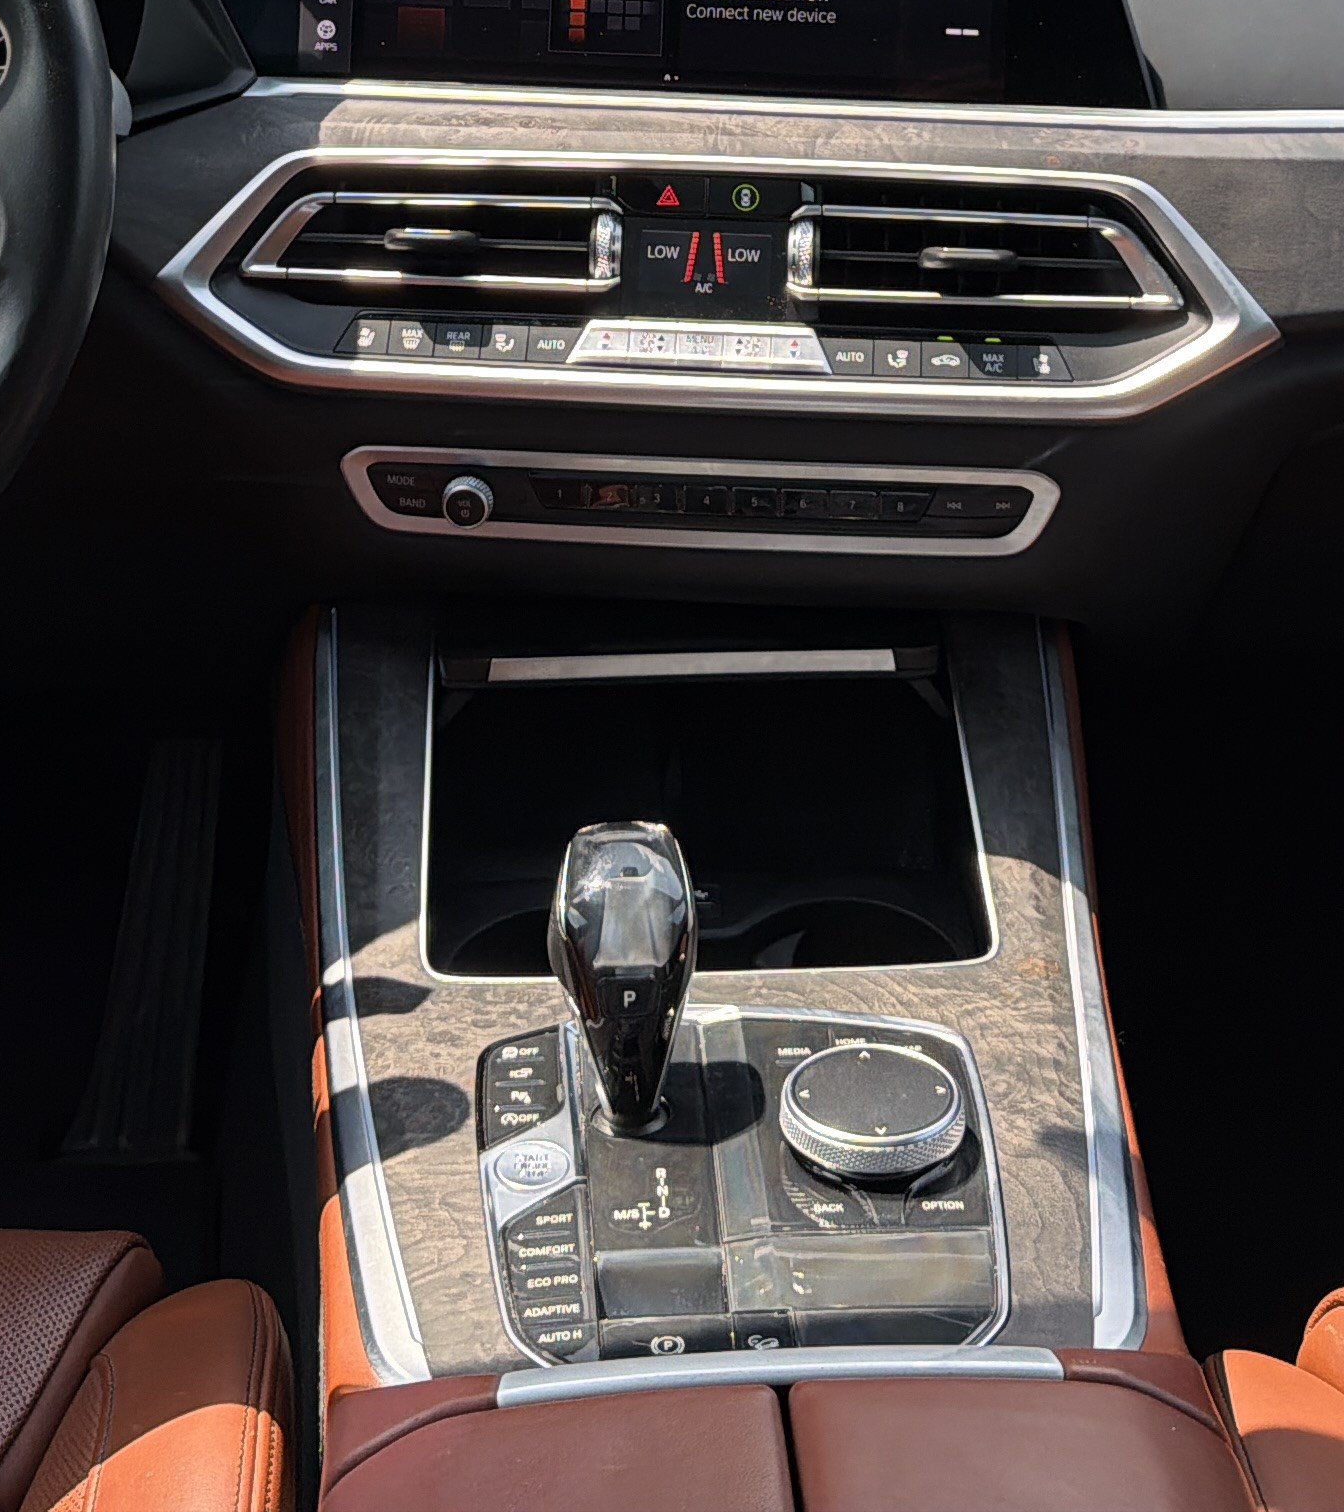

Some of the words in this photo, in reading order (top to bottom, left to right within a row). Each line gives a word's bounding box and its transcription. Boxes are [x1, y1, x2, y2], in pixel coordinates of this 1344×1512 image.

[686, 3, 749, 21] Connect
[753, 7, 784, 22] new
[787, 7, 837, 24] device
[314, 41, 338, 52] APPS
[646, 245, 680, 259] LOW
[727, 248, 761, 263] LOW
[694, 282, 713, 293] A/C
[401, 328, 423, 338] MAX
[446, 331, 470, 340] REAR
[536, 339, 565, 350] AUTO
[835, 350, 864, 363] AUTO
[982, 353, 1004, 363] MAX
[984, 362, 1003, 374] A/C
[386, 474, 416, 487] MODE
[399, 497, 426, 508] BAND
[623, 990, 637, 1008] P
[519, 1046, 540, 1056] OFF
[777, 1047, 812, 1056] MEDIA
[518, 1113, 540, 1123] OFF
[656, 1167, 667, 1179] R
[657, 1185, 669, 1197] N
[813, 1202, 845, 1214] BACK
[921, 1200, 965, 1211] OPTION
[613, 1208, 640, 1221] M/S
[659, 1207, 670, 1219] D
[536, 1213, 574, 1226] SPORT
[518, 1243, 576, 1258] COMFORT
[527, 1277, 551, 1289] ECO
[553, 1274, 579, 1286] PRO
[524, 1303, 581, 1318] ADAPTIVE
[537, 1330, 571, 1344] AUTO
[572, 1328, 583, 1340] H
